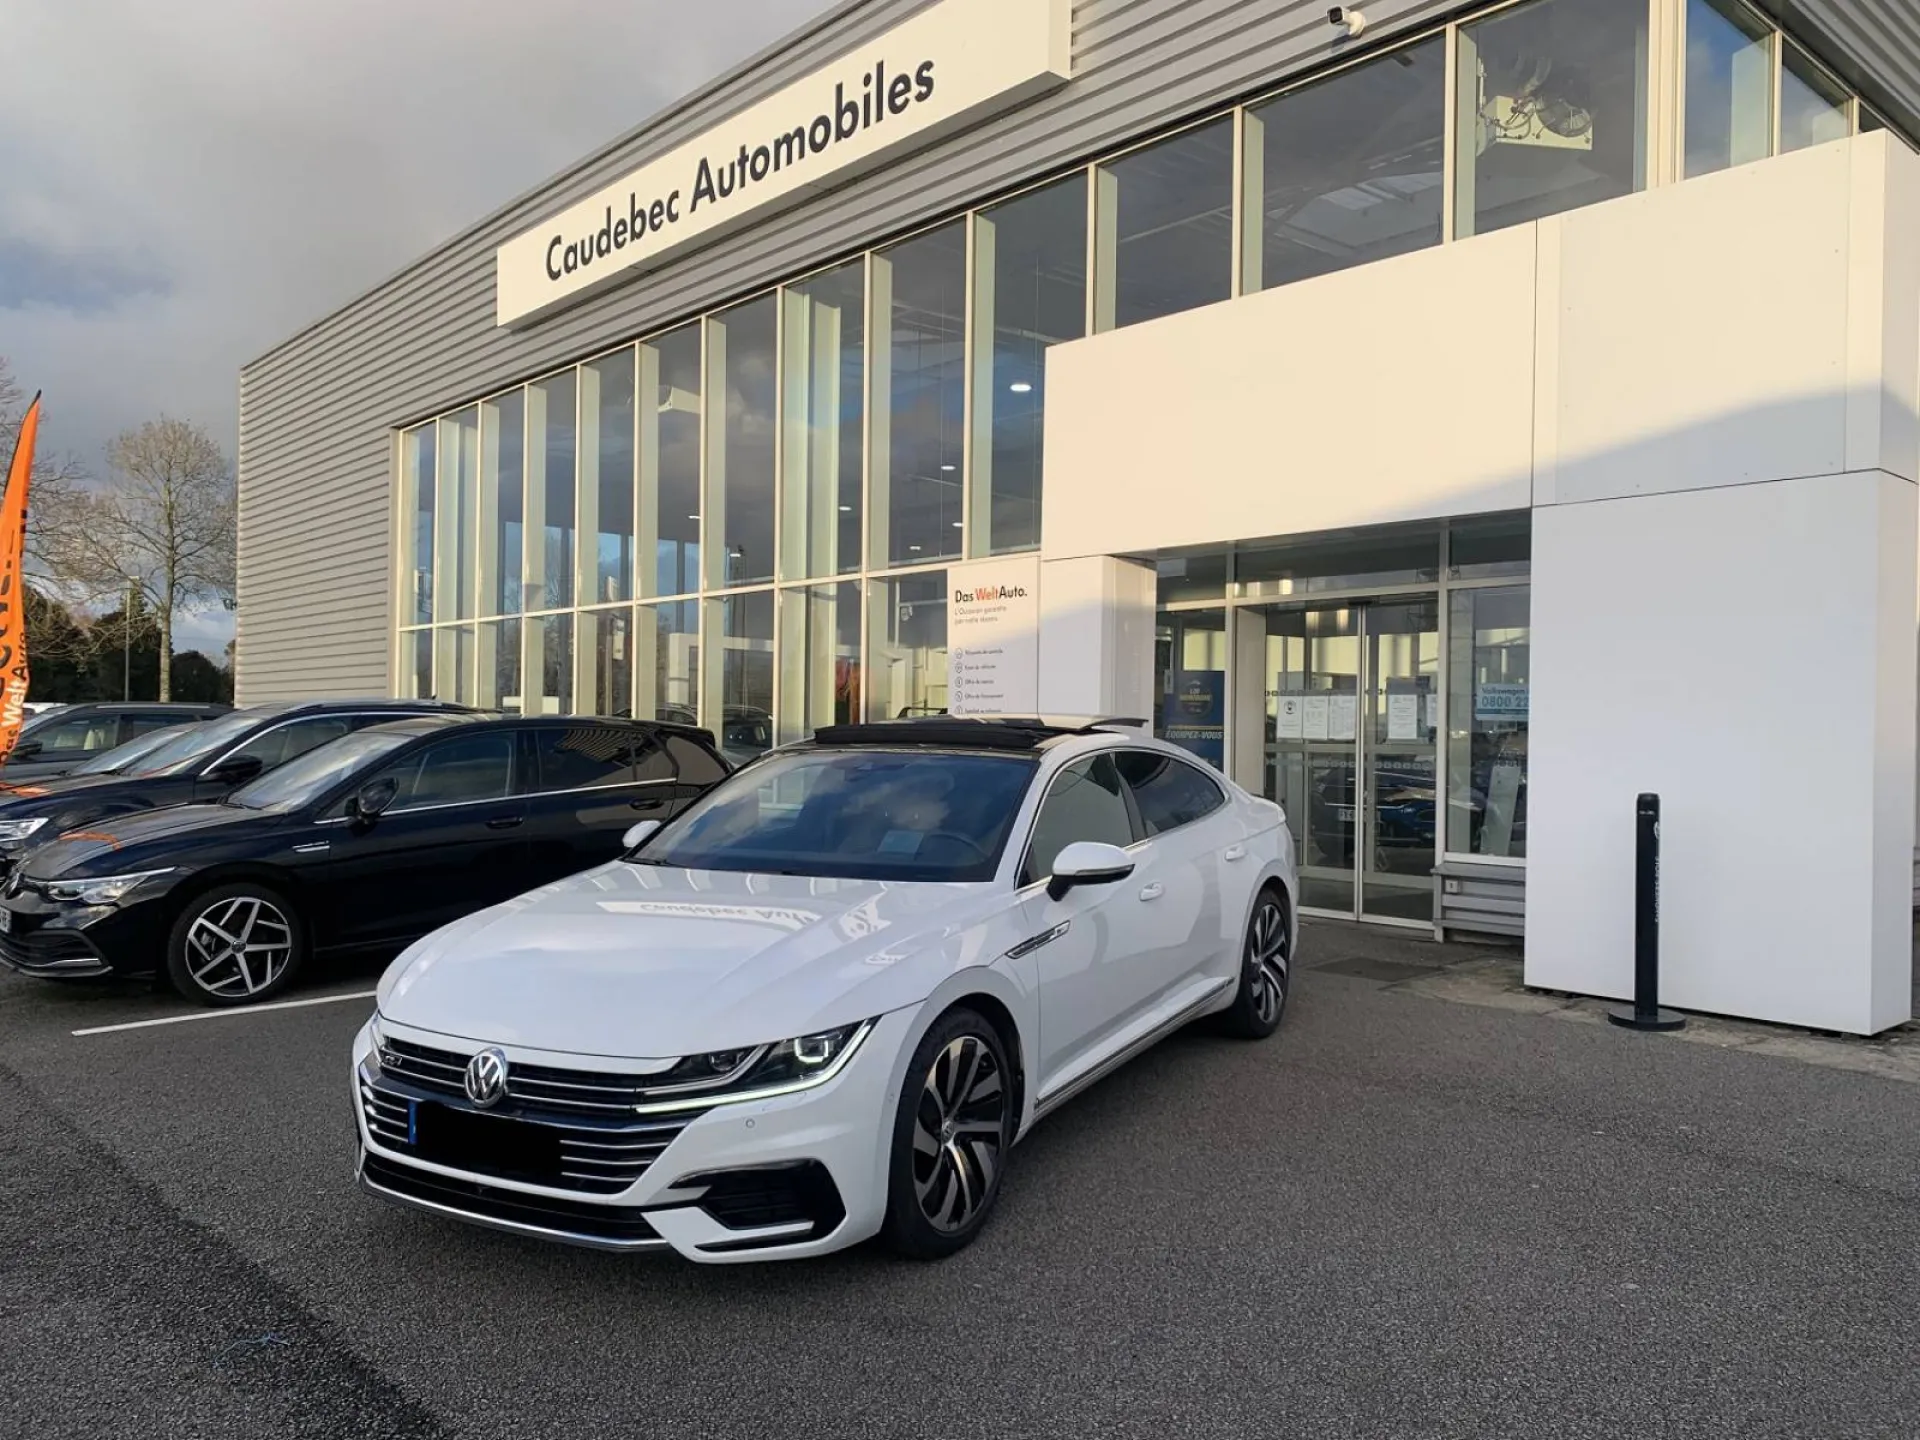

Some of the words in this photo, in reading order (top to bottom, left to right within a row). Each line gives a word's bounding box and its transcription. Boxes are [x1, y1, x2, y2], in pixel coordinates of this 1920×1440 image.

[545, 190, 680, 281] Caudebec
[689, 59, 936, 213] Automobiles
[955, 589, 974, 603] Das
[1481, 695, 1512, 708] 0800
